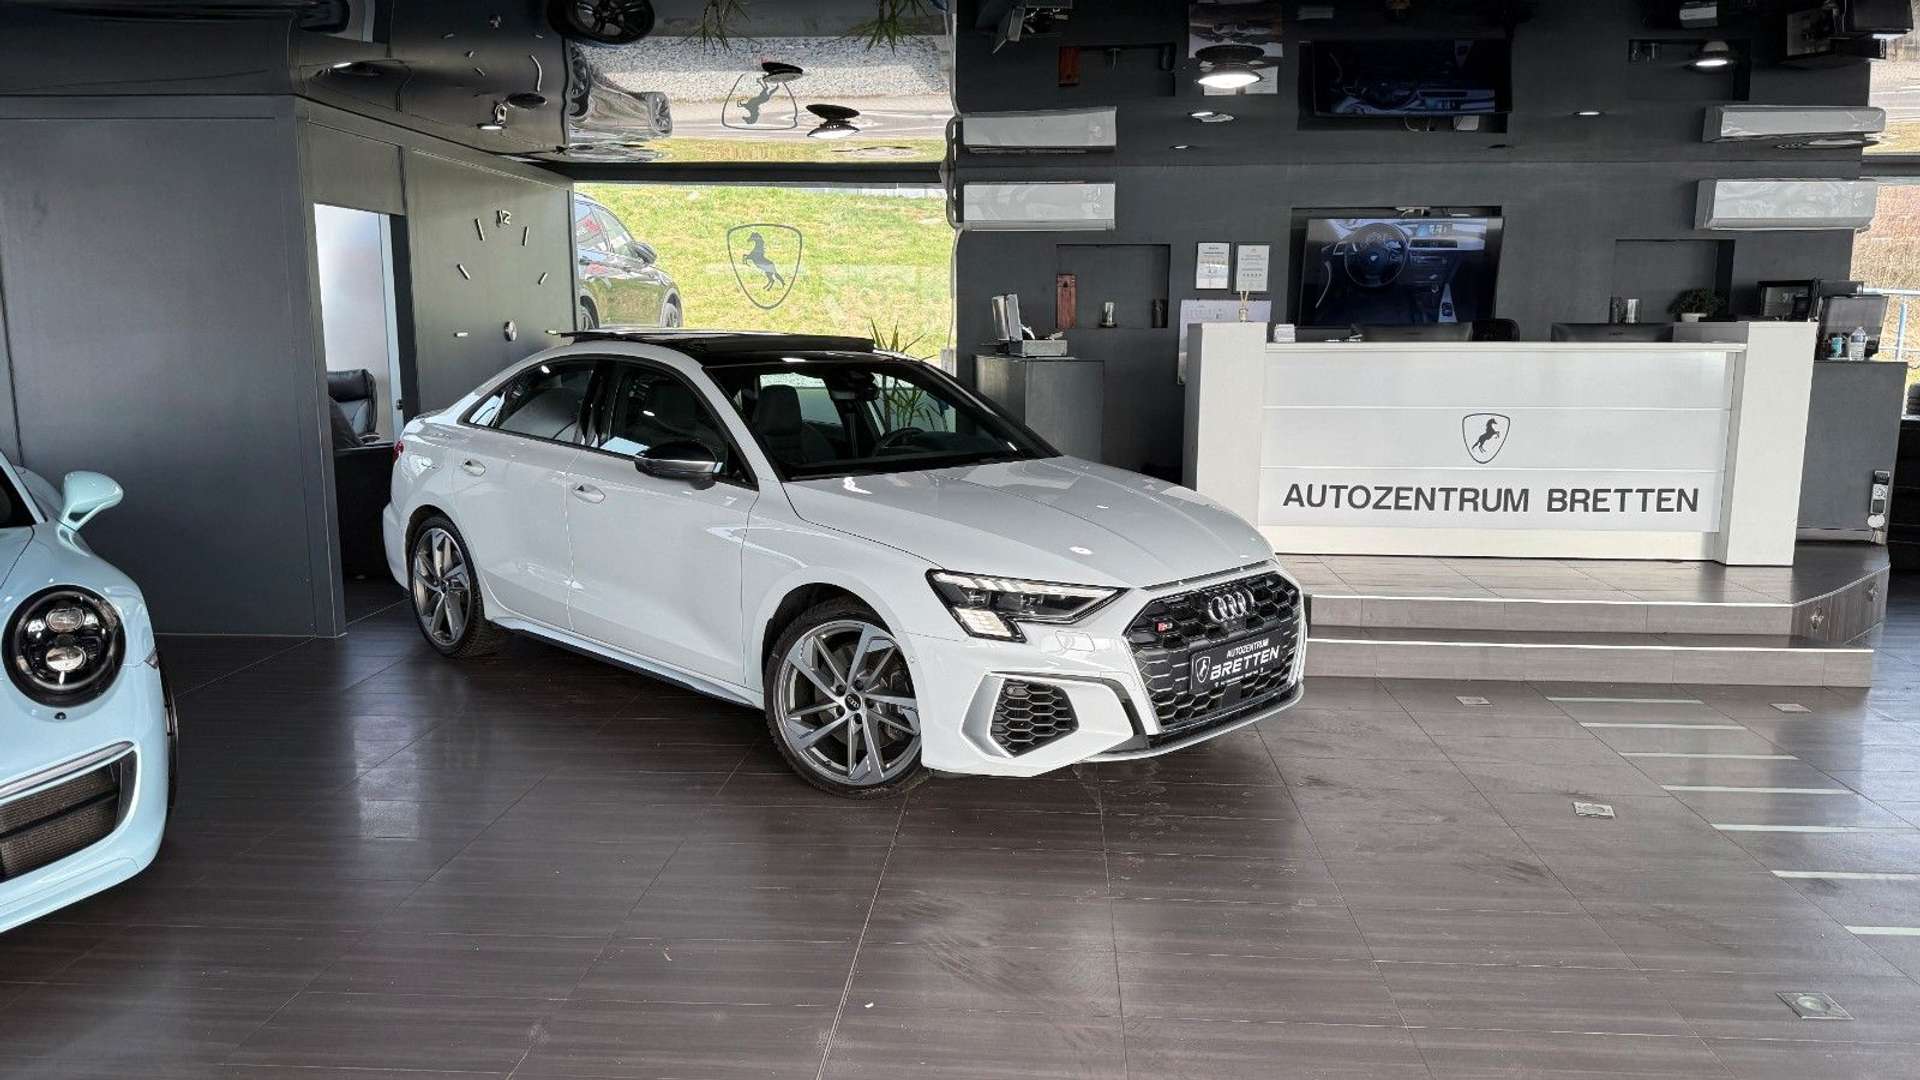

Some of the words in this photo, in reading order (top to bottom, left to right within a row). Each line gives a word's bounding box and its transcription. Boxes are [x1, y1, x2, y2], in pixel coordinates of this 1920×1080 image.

[496, 210, 512, 227] 12
[1282, 483, 1529, 513] AUTOZENTRUM
[1546, 487, 1699, 513] BRETTEN
[1226, 638, 1270, 659] AUTOZENTRUM
[1209, 645, 1281, 681] BRETTEN
